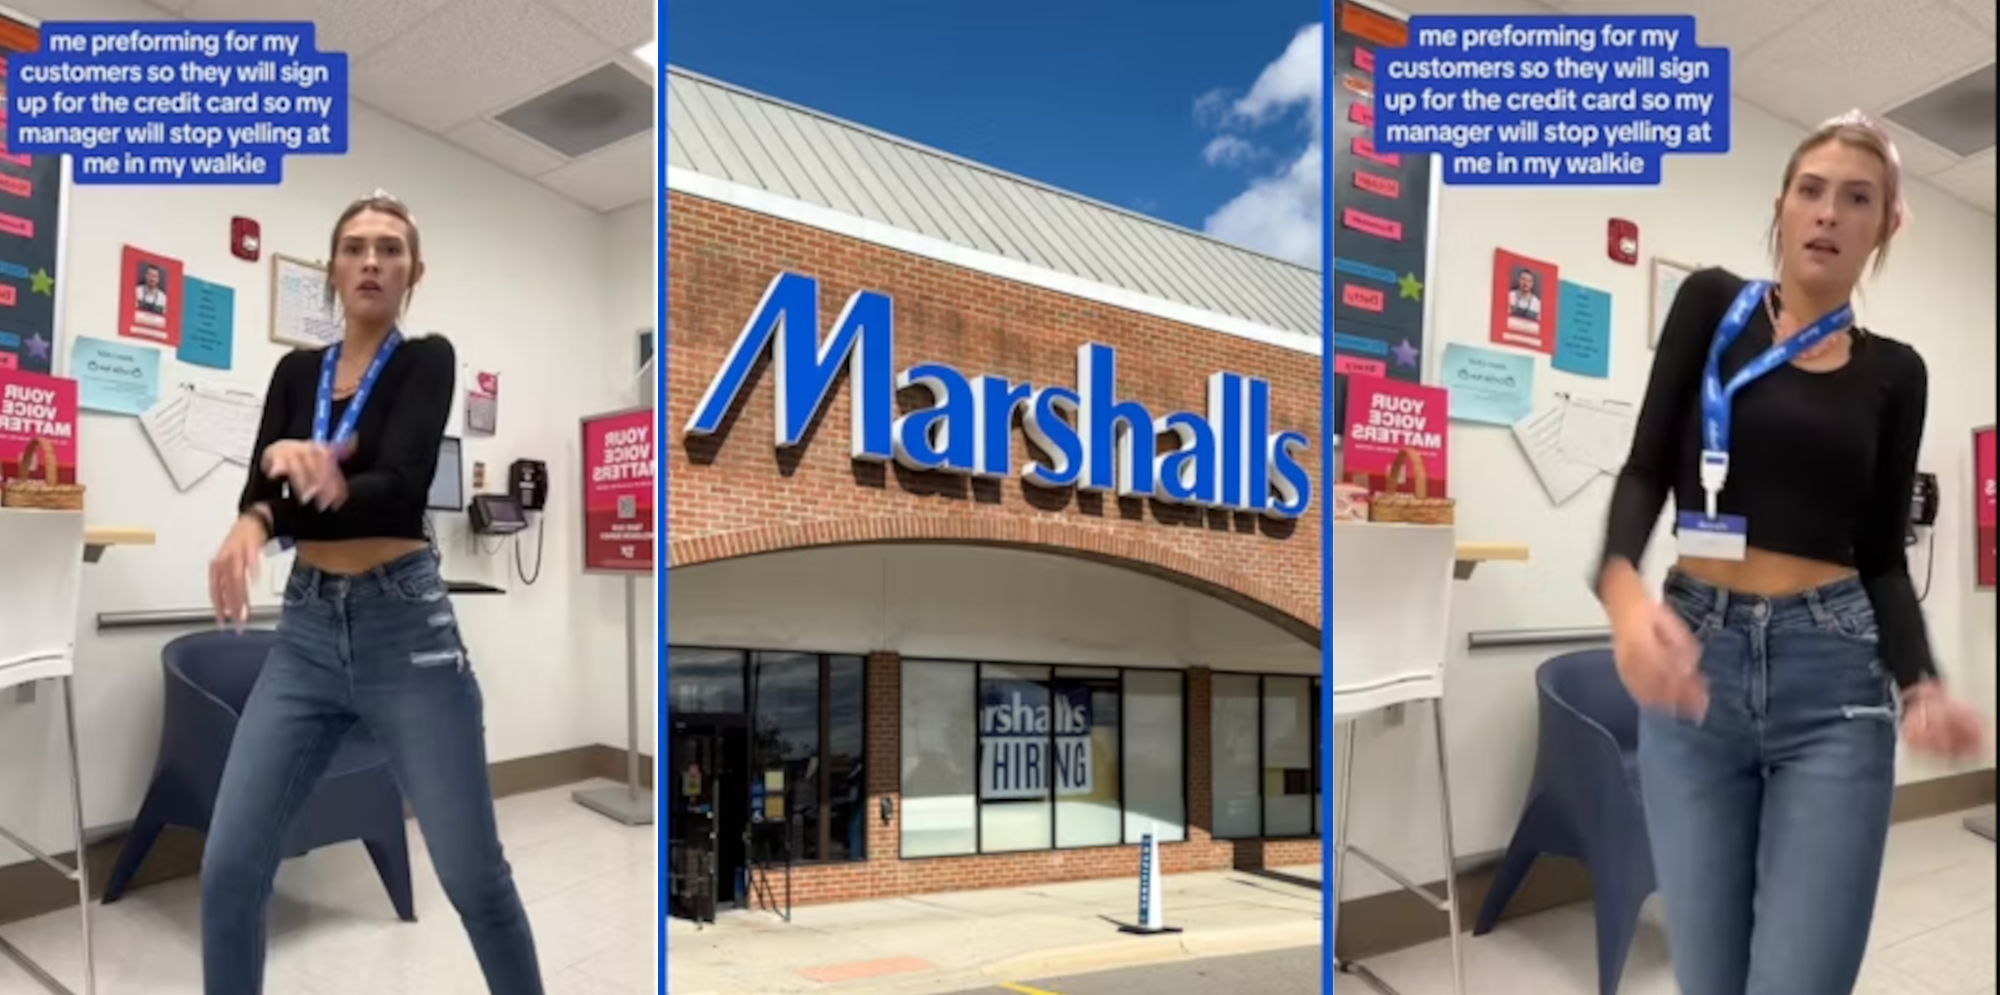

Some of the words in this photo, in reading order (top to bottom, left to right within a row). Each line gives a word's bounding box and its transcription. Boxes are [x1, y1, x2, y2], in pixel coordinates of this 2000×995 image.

[685, 271, 1311, 520] Marshalls
[980, 691, 1087, 734] rshalls
[992, 741, 1086, 791] HIRING
